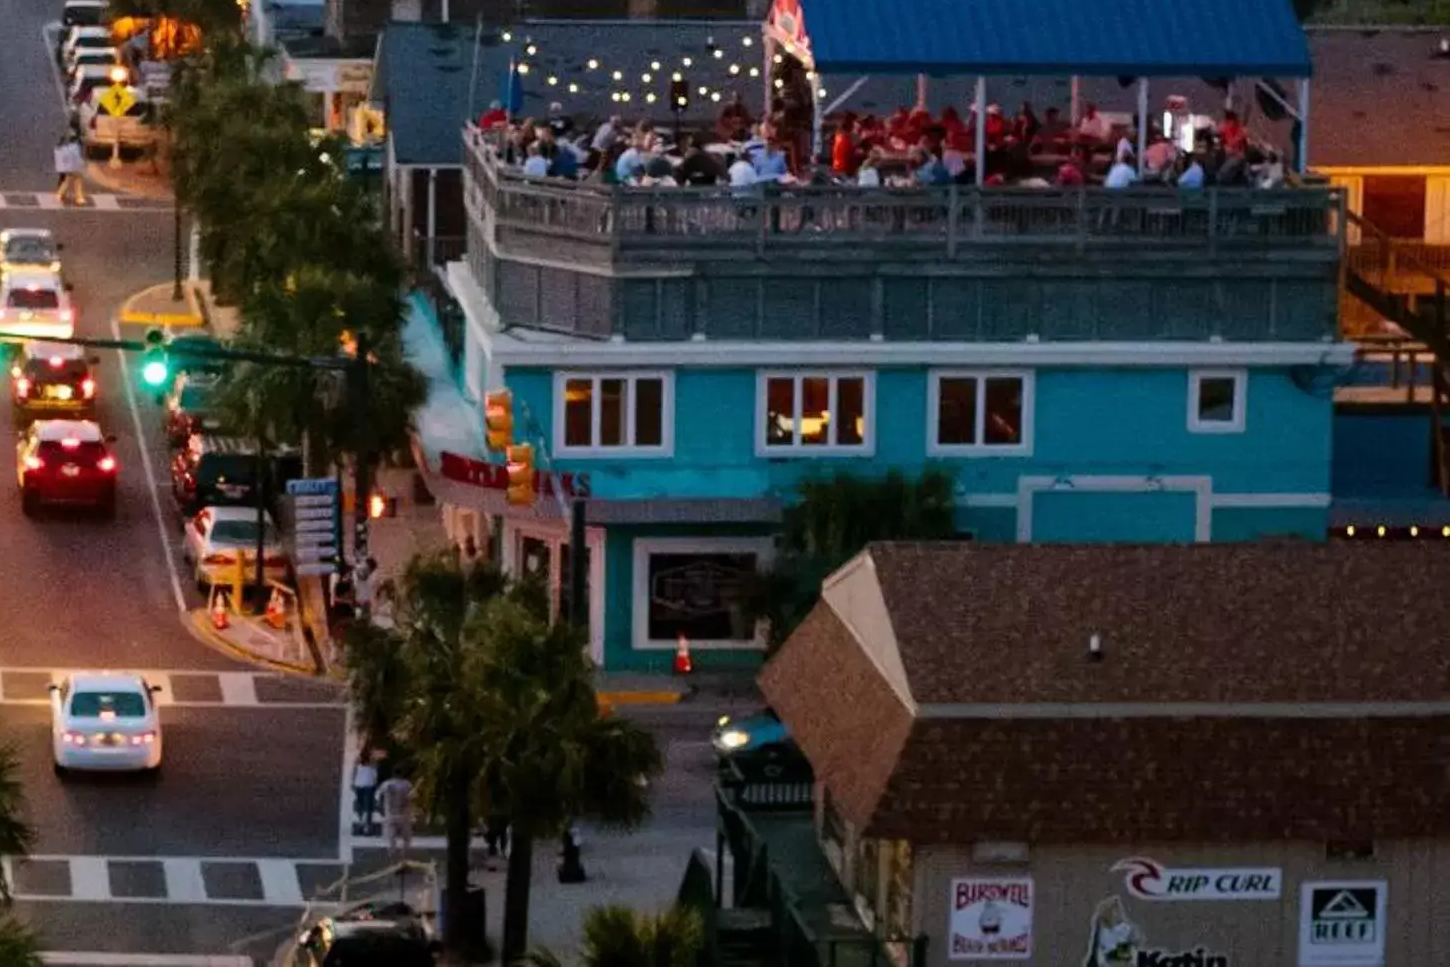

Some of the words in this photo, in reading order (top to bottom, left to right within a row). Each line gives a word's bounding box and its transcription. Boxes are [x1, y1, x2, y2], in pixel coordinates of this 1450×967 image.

[1166, 874, 1211, 893] RIP
[1215, 874, 1275, 893] CURL
[1315, 921, 1369, 940] REEF
